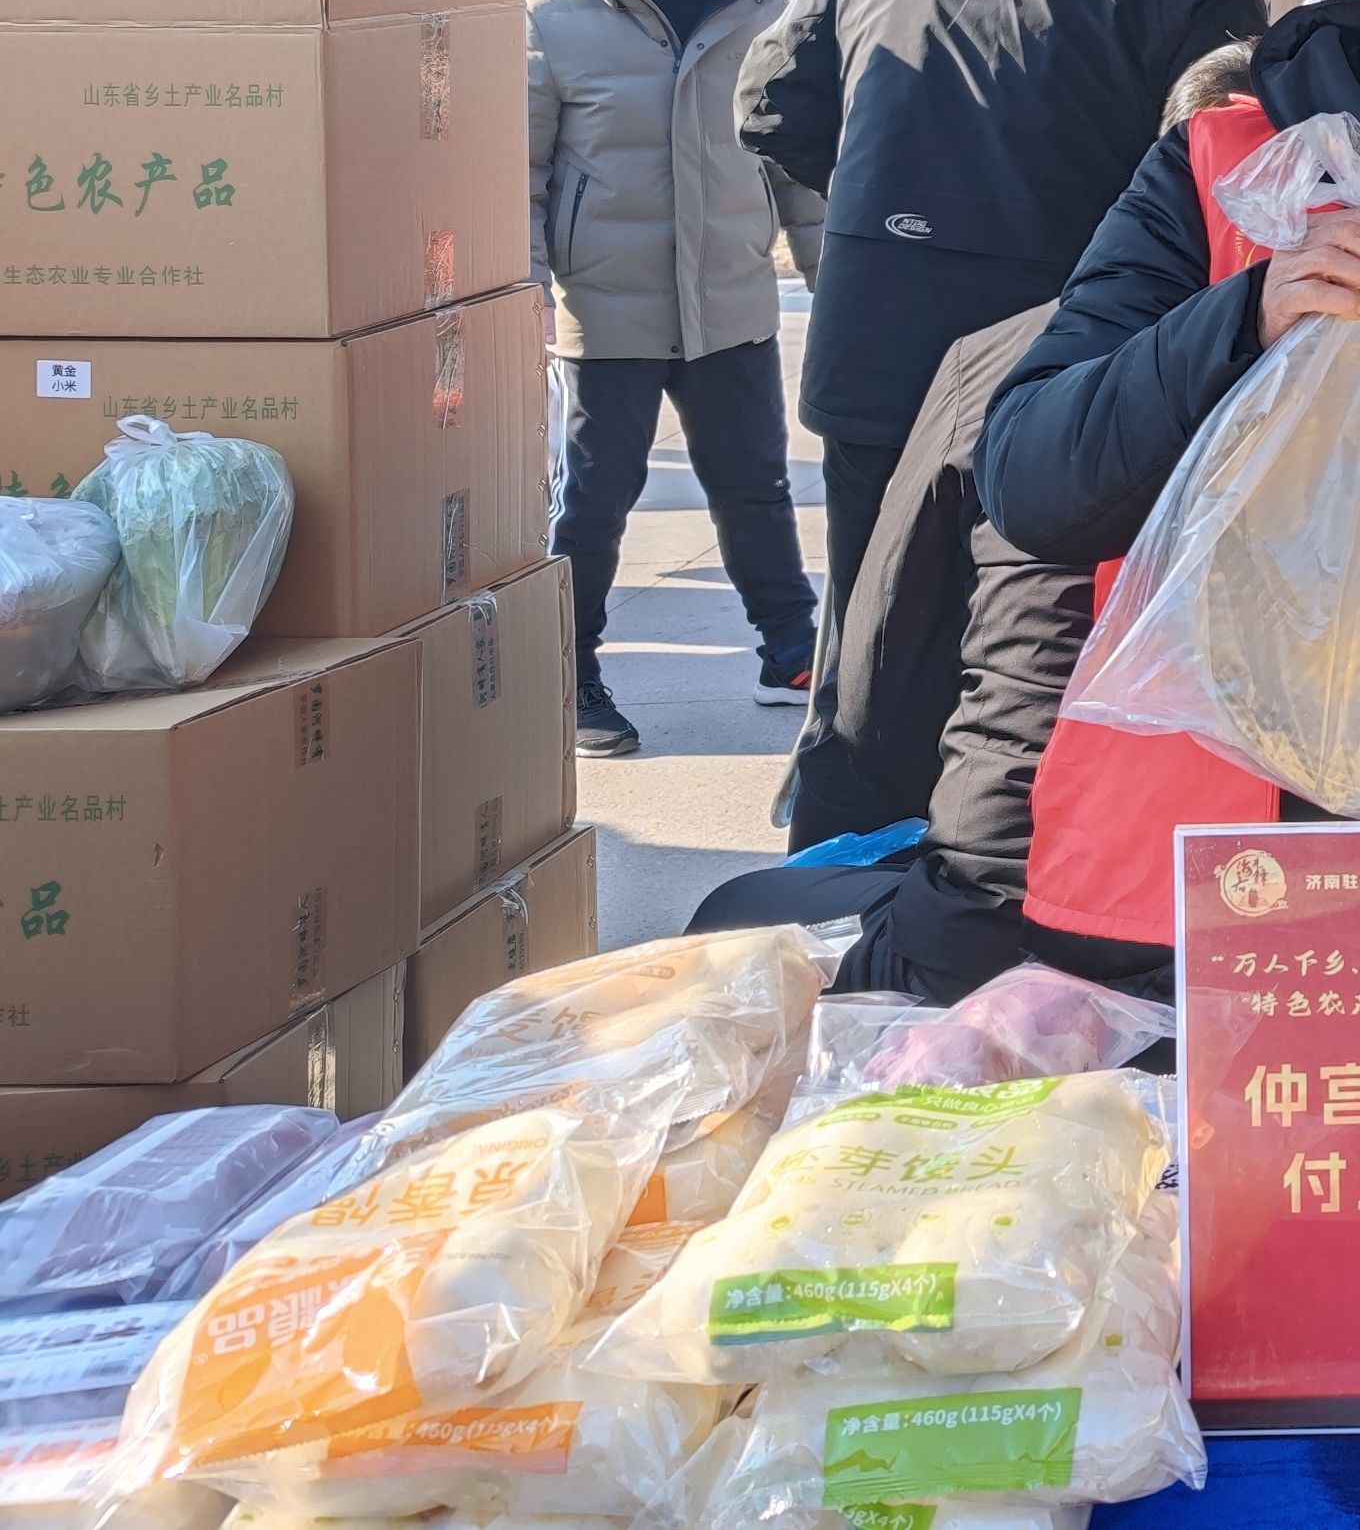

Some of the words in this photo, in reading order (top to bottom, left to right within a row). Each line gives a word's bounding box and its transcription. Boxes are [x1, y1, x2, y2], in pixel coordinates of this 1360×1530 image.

[83, 83, 284, 108] 山东省乡土产业名品村
[0, 152, 236, 218] 色农产品
[3, 265, 204, 286] 生态农业专业合作社
[51, 364, 77, 378] 黄金
[51, 379, 77, 393] 小米
[103, 396, 299, 420] 山东省乡土产业名品村
